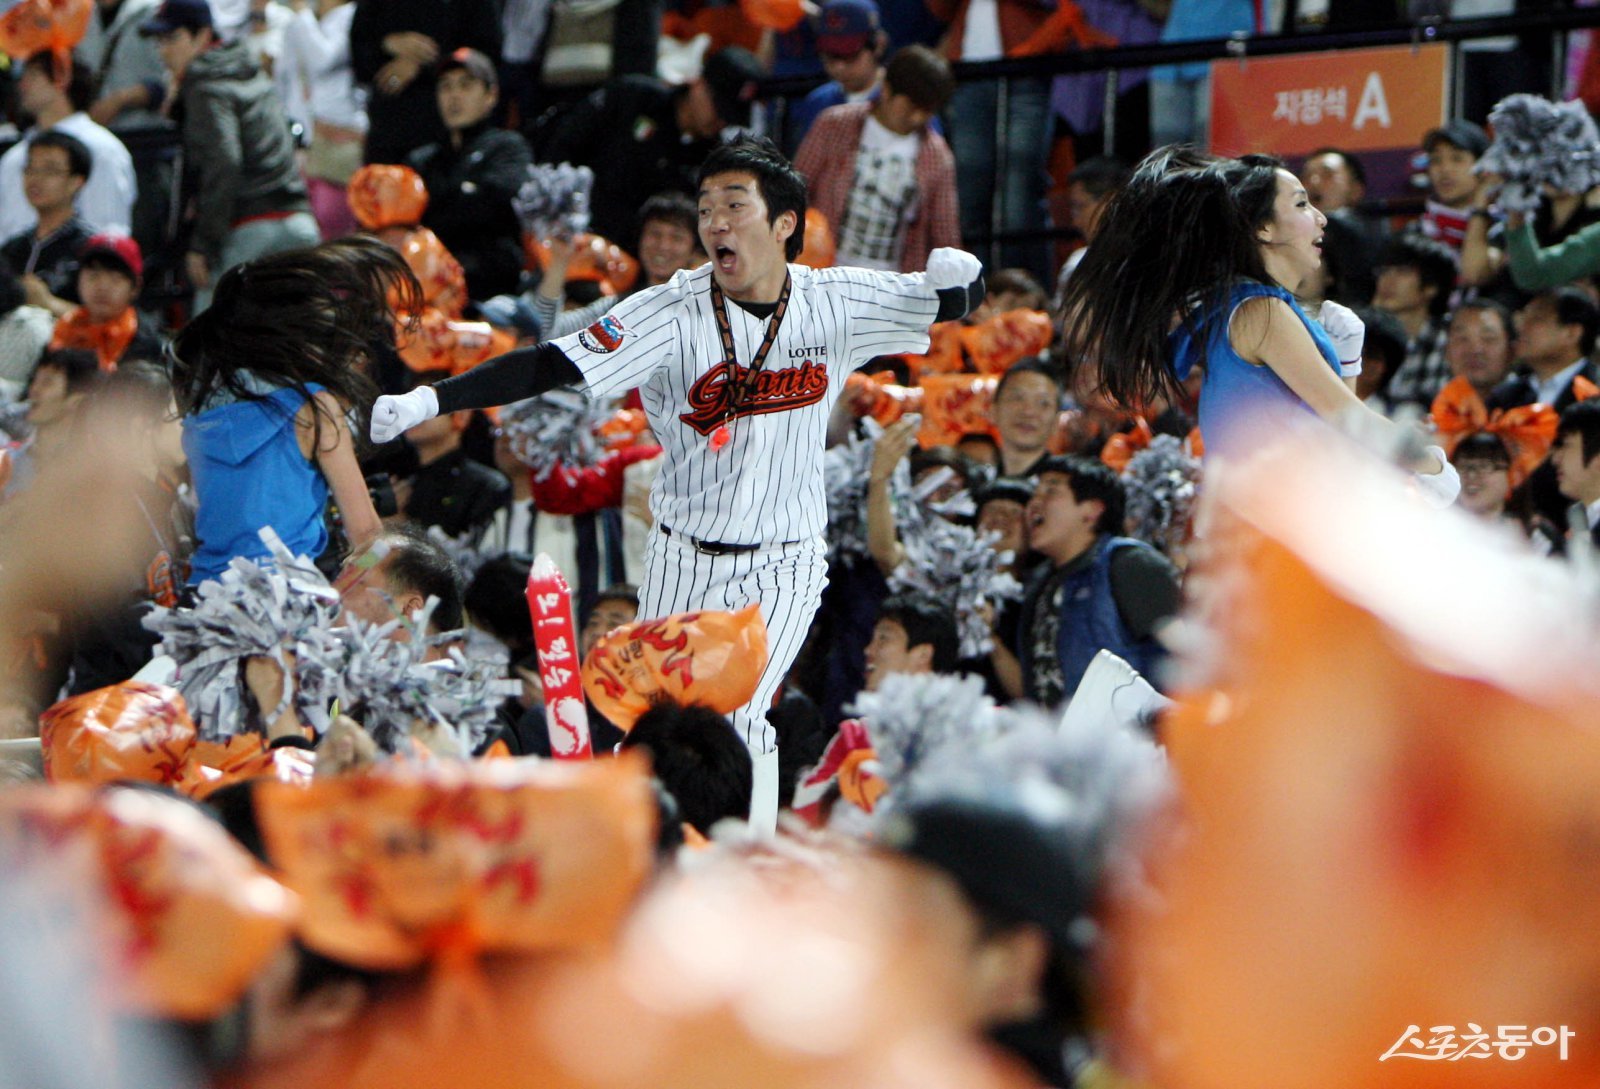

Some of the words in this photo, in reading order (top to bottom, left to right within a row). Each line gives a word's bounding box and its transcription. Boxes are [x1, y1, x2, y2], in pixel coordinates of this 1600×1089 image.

[1273, 87, 1347, 125] 지정석
[1352, 71, 1391, 130] A
[788, 346, 827, 358] LOTTE
